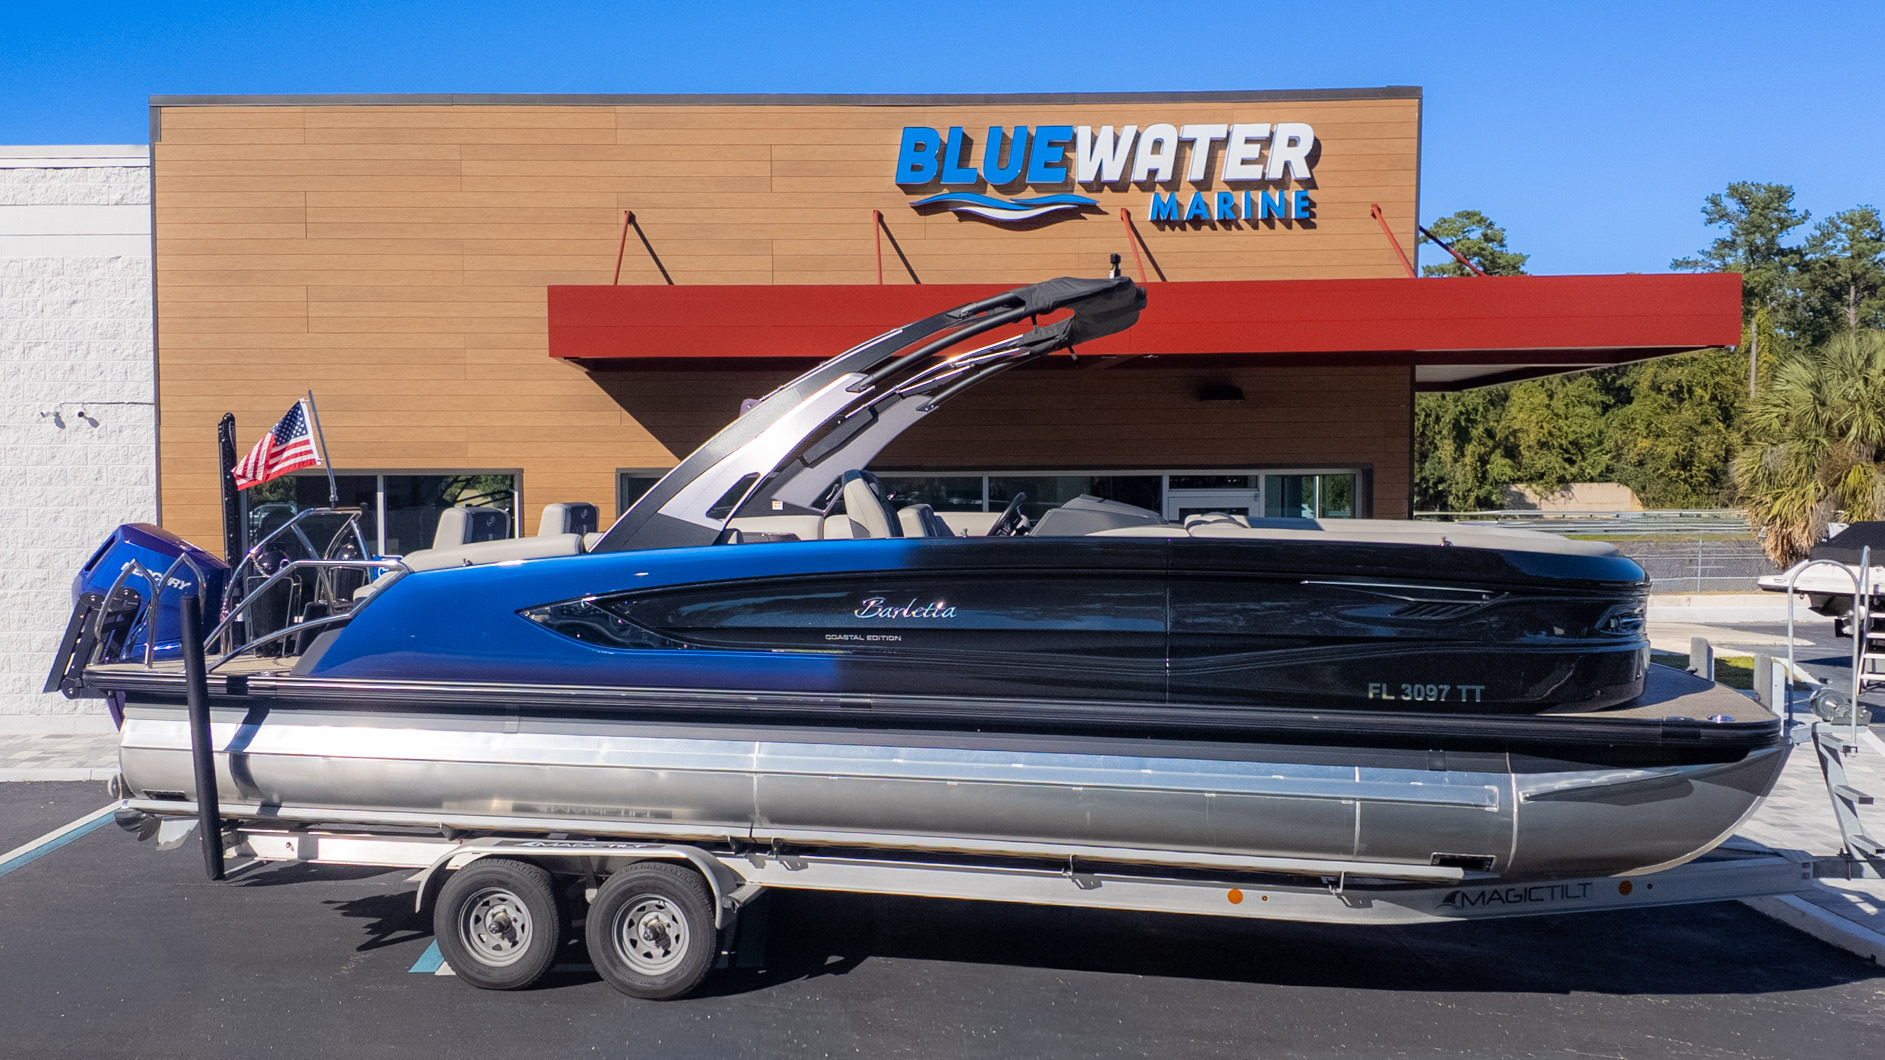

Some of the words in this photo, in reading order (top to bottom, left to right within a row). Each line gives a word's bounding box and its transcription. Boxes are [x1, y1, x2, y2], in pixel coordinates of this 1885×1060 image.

[895, 122, 1315, 185] BLUEWATER
[1148, 190, 1311, 221] MARINE
[854, 596, 958, 619] Barletta
[1368, 683, 1396, 700] FL
[1401, 684, 1451, 701] 3097
[1456, 685, 1486, 703] TT
[1461, 882, 1593, 907] MAGICTILT
